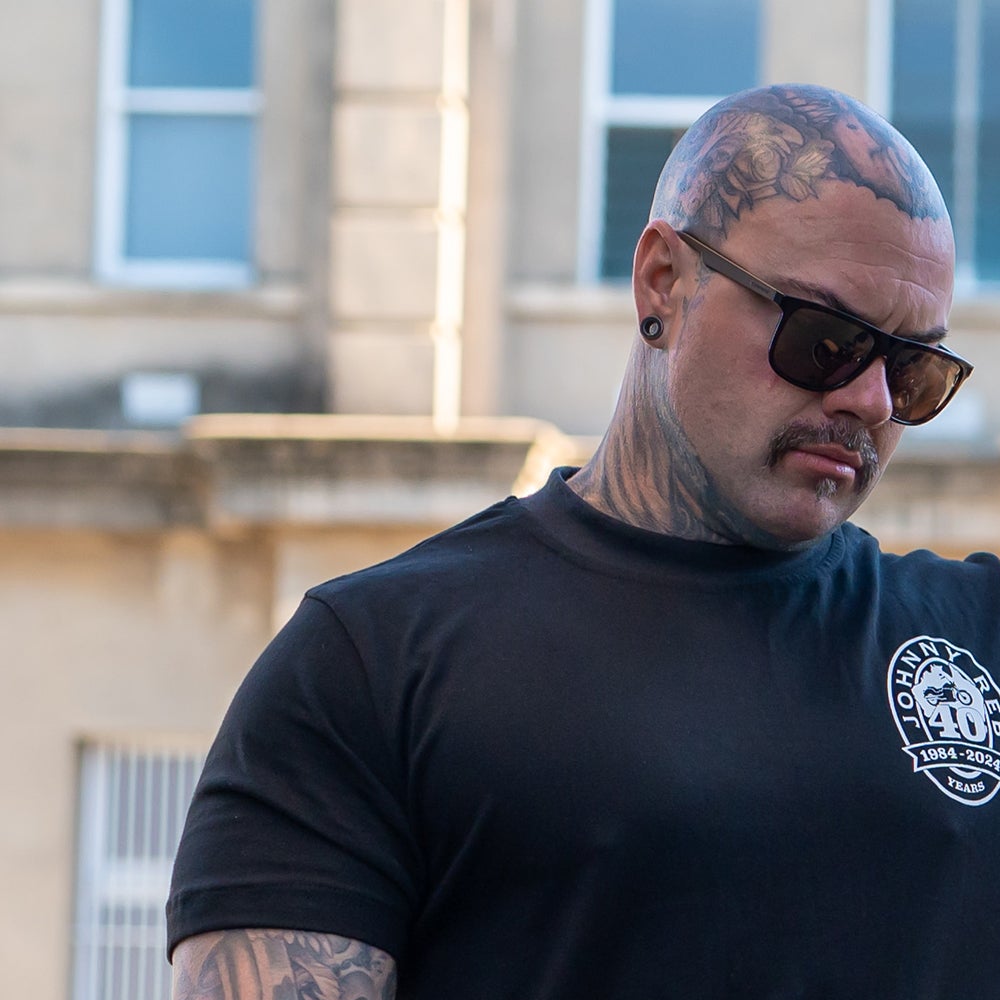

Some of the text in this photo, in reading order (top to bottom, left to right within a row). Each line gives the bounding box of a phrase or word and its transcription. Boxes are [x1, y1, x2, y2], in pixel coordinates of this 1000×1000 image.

[896, 642, 961, 729] JOHNNY
[928, 703, 988, 743] 40
[947, 776, 985, 793] YEARS
